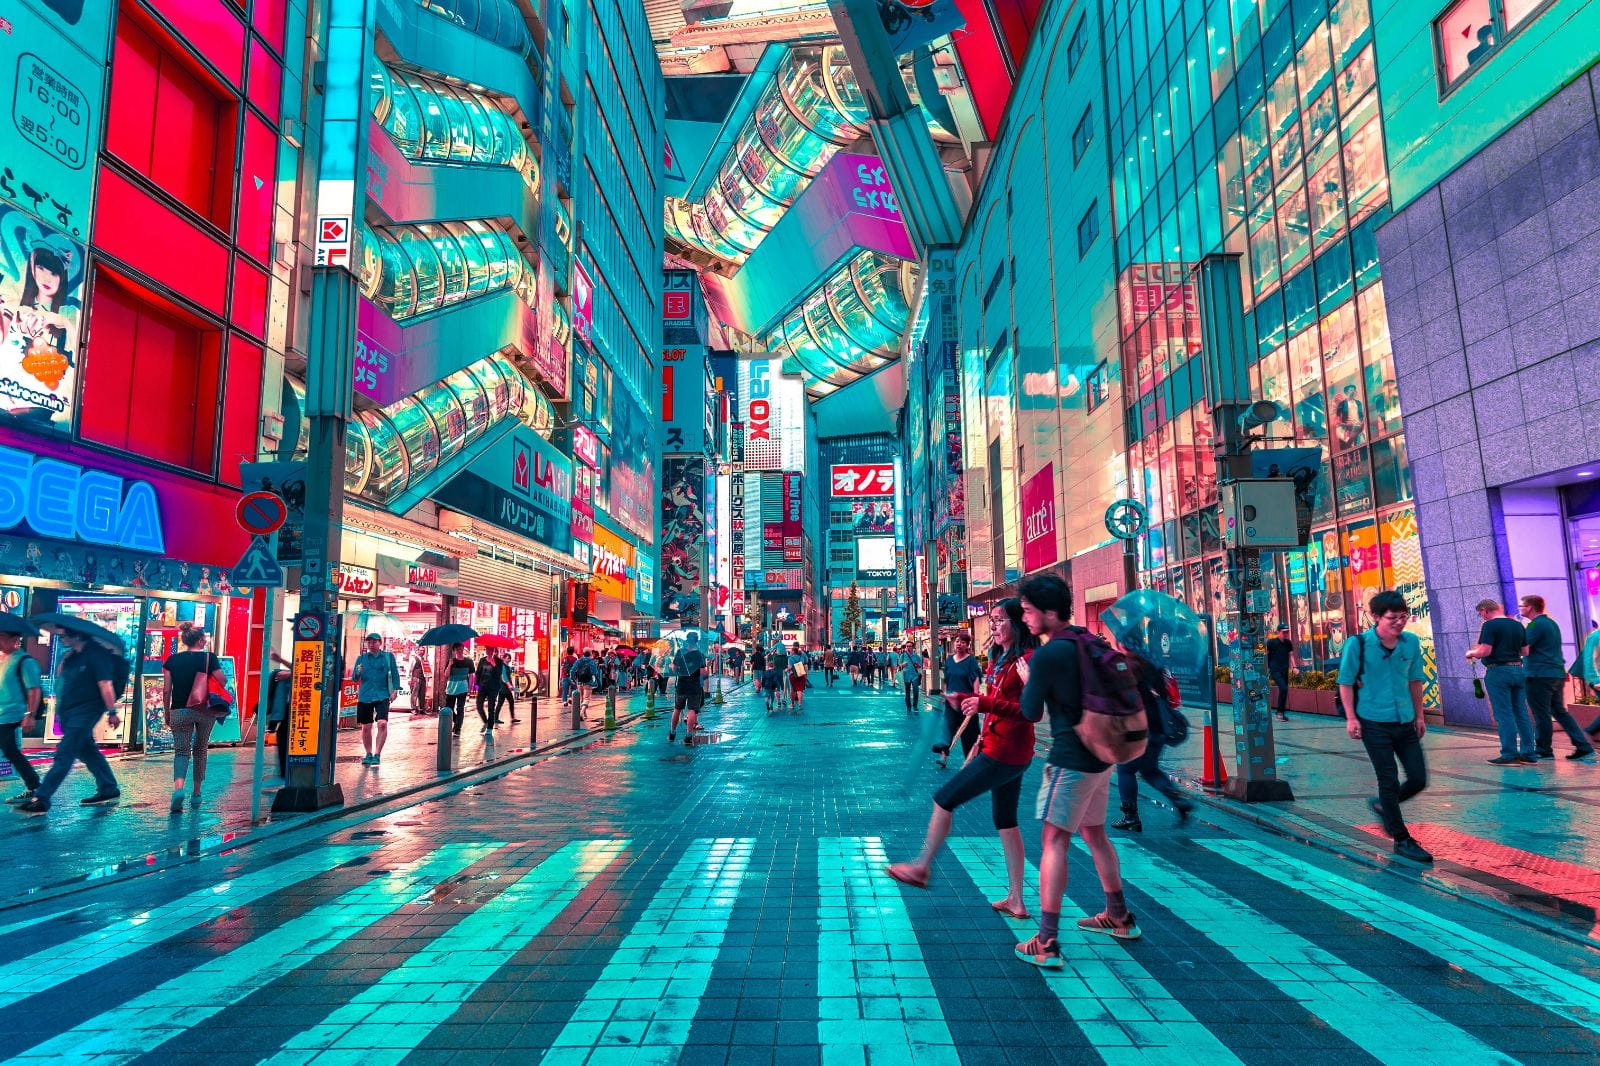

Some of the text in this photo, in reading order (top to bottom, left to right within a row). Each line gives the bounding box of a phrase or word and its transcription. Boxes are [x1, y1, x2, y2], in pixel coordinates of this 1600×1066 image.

[26, 77, 80, 126] 16:00
[32, 63, 79, 107] 営業時間
[21, 114, 79, 164] 翌5:00
[356, 339, 389, 374] カメラ
[0, 446, 165, 554] SEGA
[533, 450, 571, 502] LABI
[533, 488, 570, 521] AKIHABARA
[418, 566, 437, 583] LABI
[297, 649, 314, 751] 路上喫煙禁止です。
